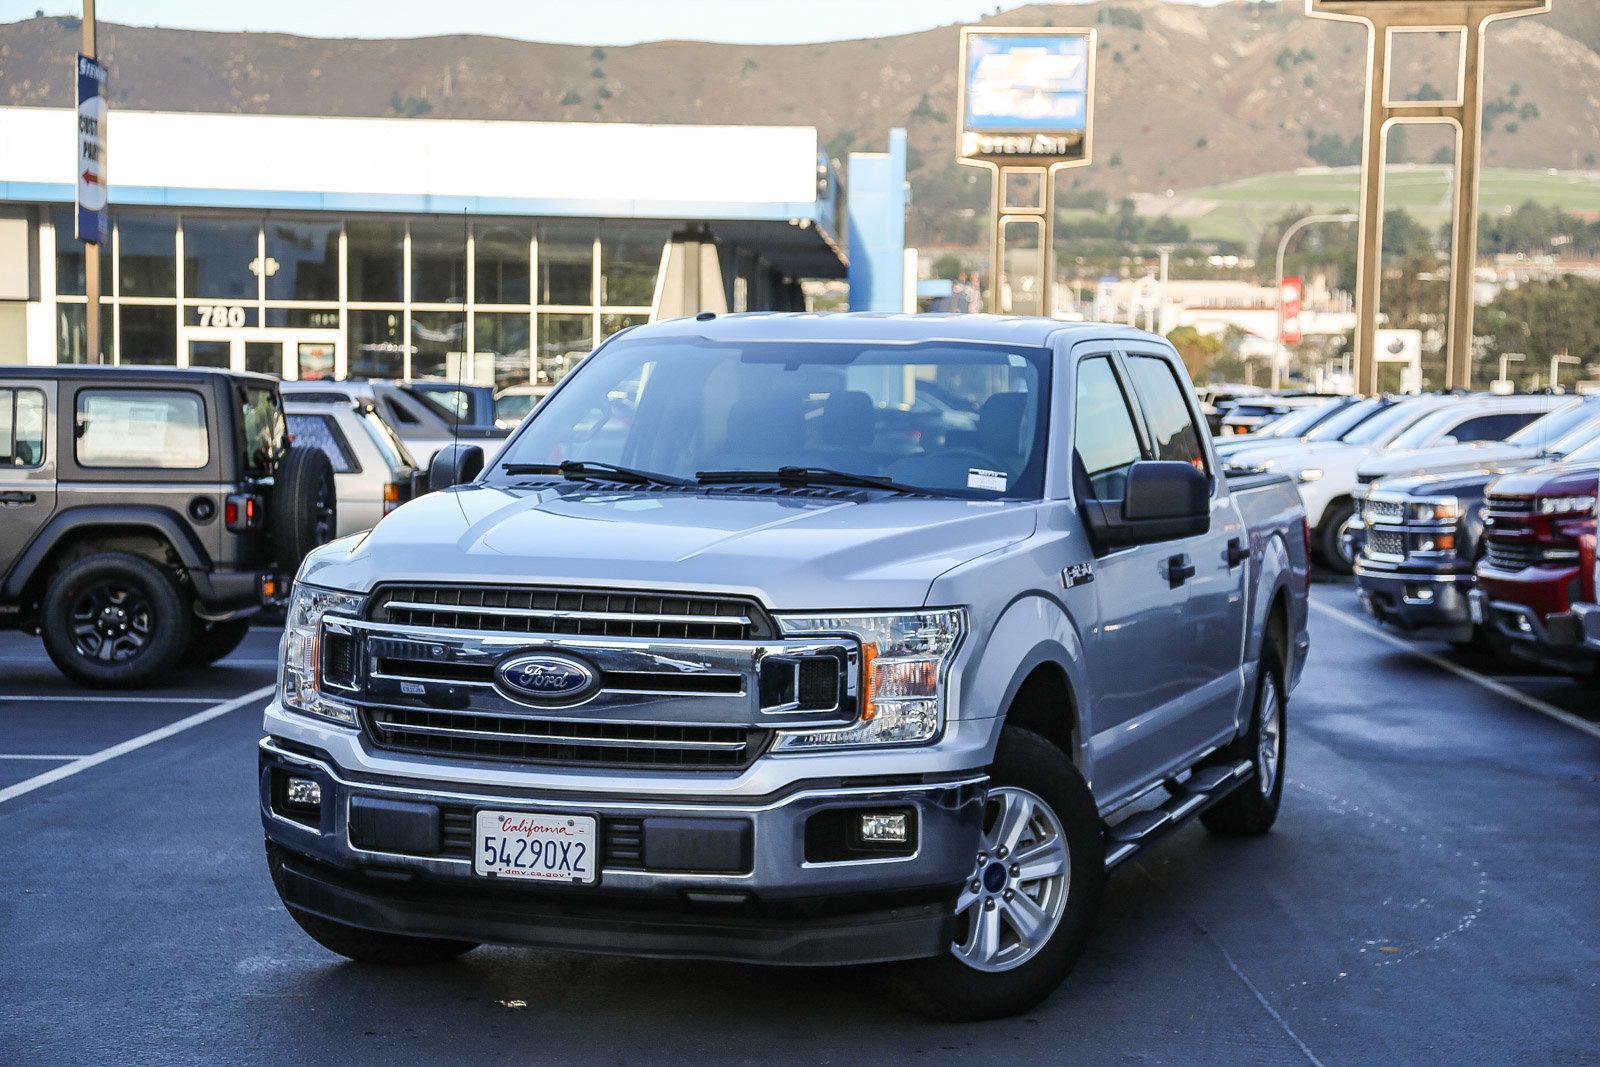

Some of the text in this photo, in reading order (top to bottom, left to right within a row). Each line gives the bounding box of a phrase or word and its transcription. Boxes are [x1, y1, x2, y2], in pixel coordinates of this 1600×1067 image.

[197, 305, 246, 328] 780
[519, 663, 569, 688] Ford
[502, 817, 574, 837] California
[484, 836, 587, 872] 54290X2
[505, 868, 565, 878] dmv.ca.gov
